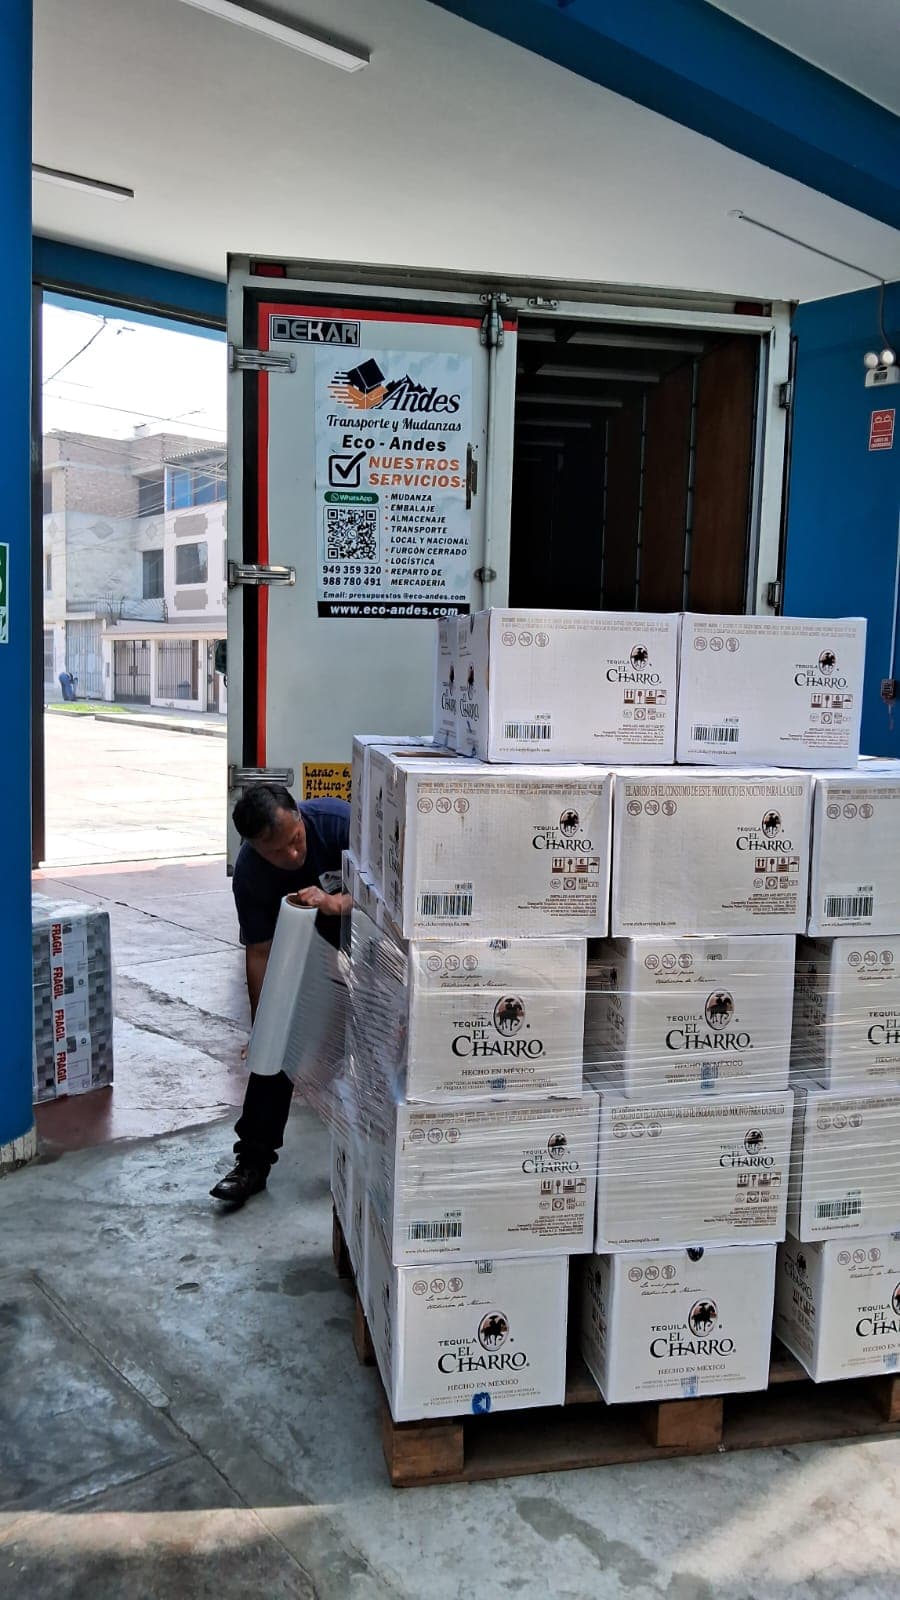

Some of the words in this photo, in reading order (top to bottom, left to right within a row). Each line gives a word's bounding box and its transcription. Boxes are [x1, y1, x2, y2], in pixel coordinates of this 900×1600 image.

[273, 318, 357, 344] DEKAR
[378, 382, 460, 414] Andes
[327, 414, 390, 431] Transporte
[392, 421, 399, 432] y
[402, 418, 461, 432] Mudanzas
[342, 434, 375, 449] Eco
[389, 437, 447, 452] Andes
[368, 456, 460, 471] NUESTROS
[368, 473, 466, 488] SERVICIOS:
[339, 495, 373, 503] WhatsApp
[390, 494, 433, 502] MUDANZA
[390, 505, 436, 513] EMBALAJE
[390, 515, 446, 523] ALMACENAJE
[391, 526, 448, 534] TRANSPORTE
[427, 548, 467, 556] CERRADO
[390, 557, 435, 565] LOGÍSTICA
[322, 566, 341, 574] 949
[343, 566, 361, 574] 359
[363, 566, 382, 574] 320
[390, 568, 429, 576] REPARTO
[431, 568, 442, 576] DE
[343, 577, 362, 586] 780
[363, 577, 382, 586] 491
[330, 604, 459, 616] www.eco-andes.com
[618, 665, 627, 673] EL
[606, 669, 661, 686] CHARRO
[794, 673, 847, 690] CHARRO
[546, 831, 558, 839] EL
[748, 832, 759, 840] EL
[532, 835, 593, 853] CHARRO
[736, 836, 793, 853] CHARRO
[684, 1023, 700, 1034] EL
[886, 1019, 897, 1028] EL
[472, 1029, 489, 1040] EL
[665, 1029, 751, 1053] CHARRO
[451, 1035, 543, 1059] CHARRO
[522, 1159, 579, 1174] CHARRO
[720, 1154, 774, 1169] CHARRO
[857, 1303, 891, 1312] TEQUILA
[874, 1311, 888, 1321] EL
[651, 1324, 688, 1332] TEQUILA
[669, 1332, 684, 1342] EL
[437, 1338, 477, 1347] TEQUILA
[457, 1347, 475, 1357] EL
[649, 1338, 734, 1358] CHARRO
[437, 1352, 527, 1374] CHARRO
[658, 1367, 685, 1375] HECHO
[447, 1383, 475, 1392] HECHO
